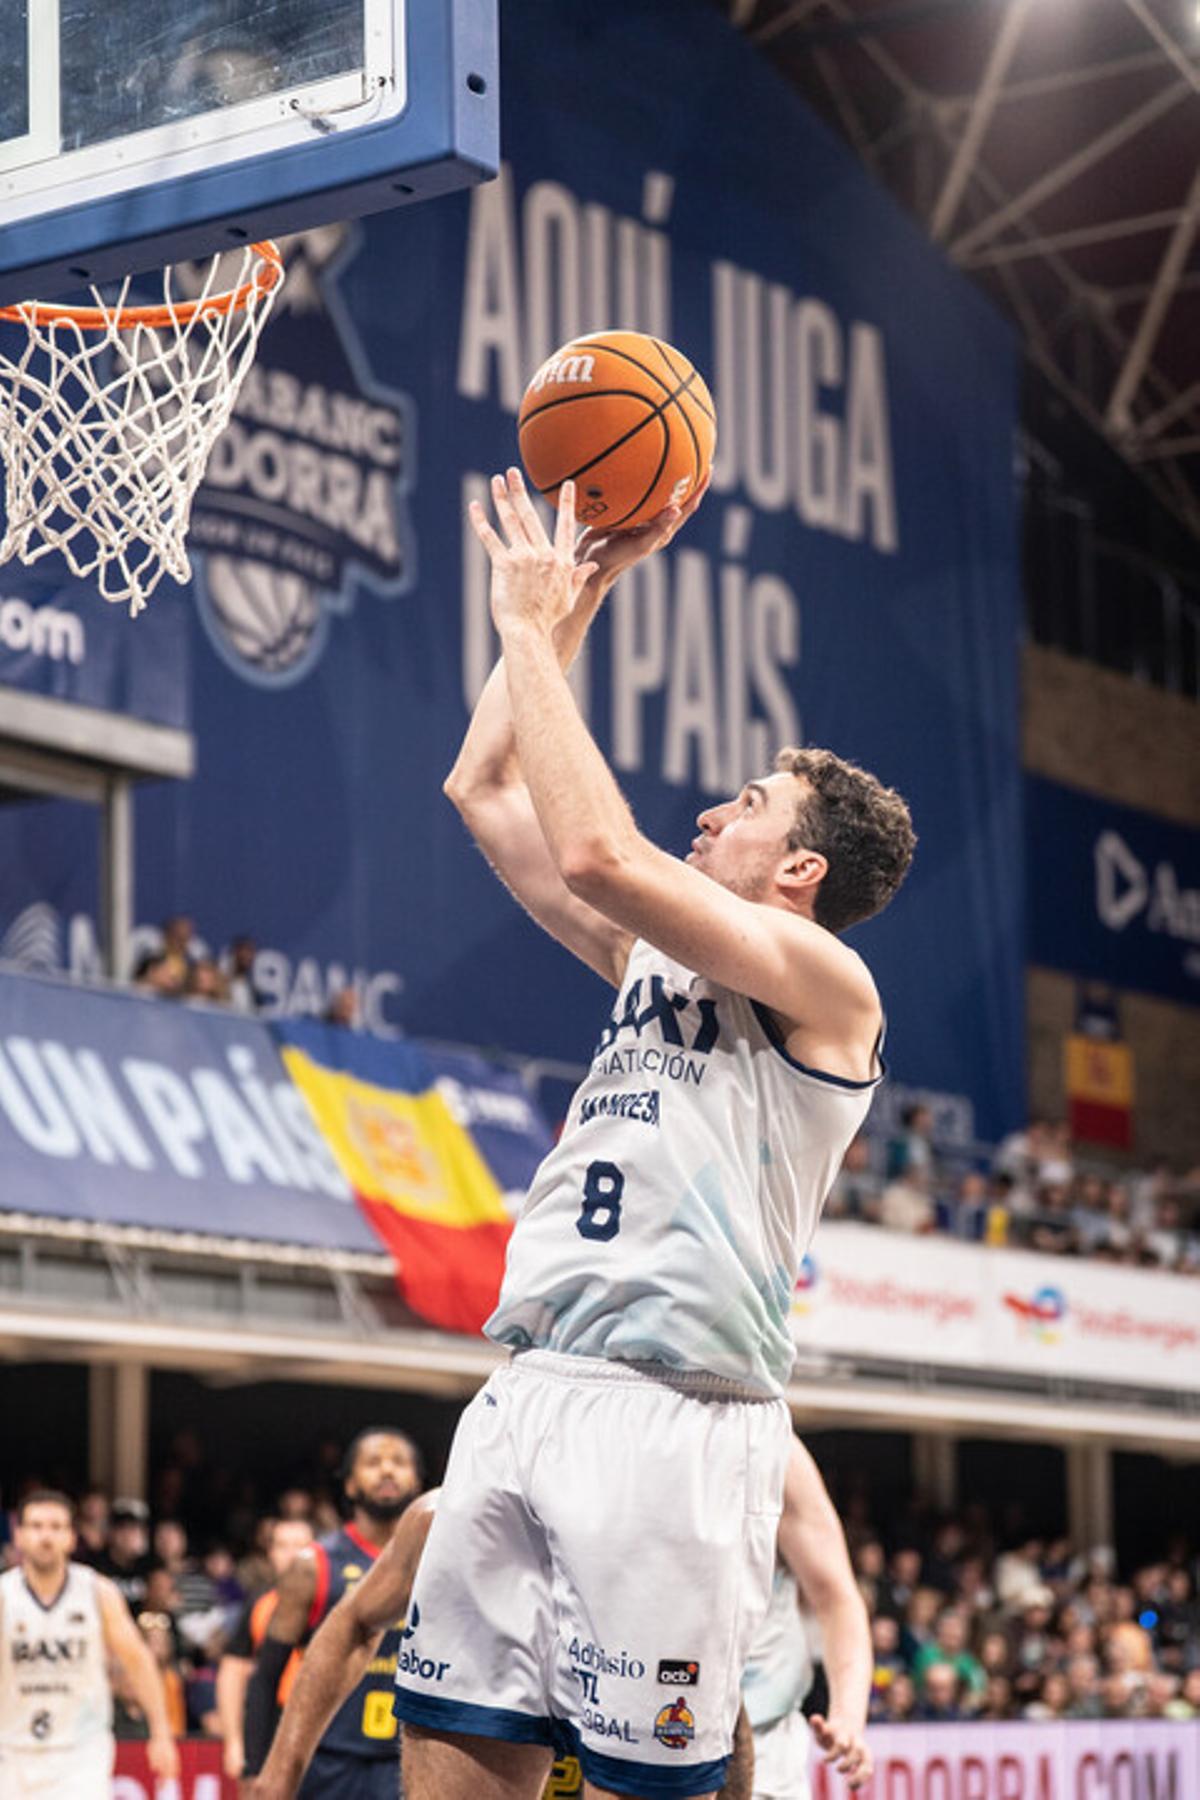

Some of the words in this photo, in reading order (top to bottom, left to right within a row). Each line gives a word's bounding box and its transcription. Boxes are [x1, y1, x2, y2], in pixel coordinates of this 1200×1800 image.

[712, 257, 897, 554] JUGA
[0, 1036, 154, 1172] UN
[576, 1159, 625, 1242] 8
